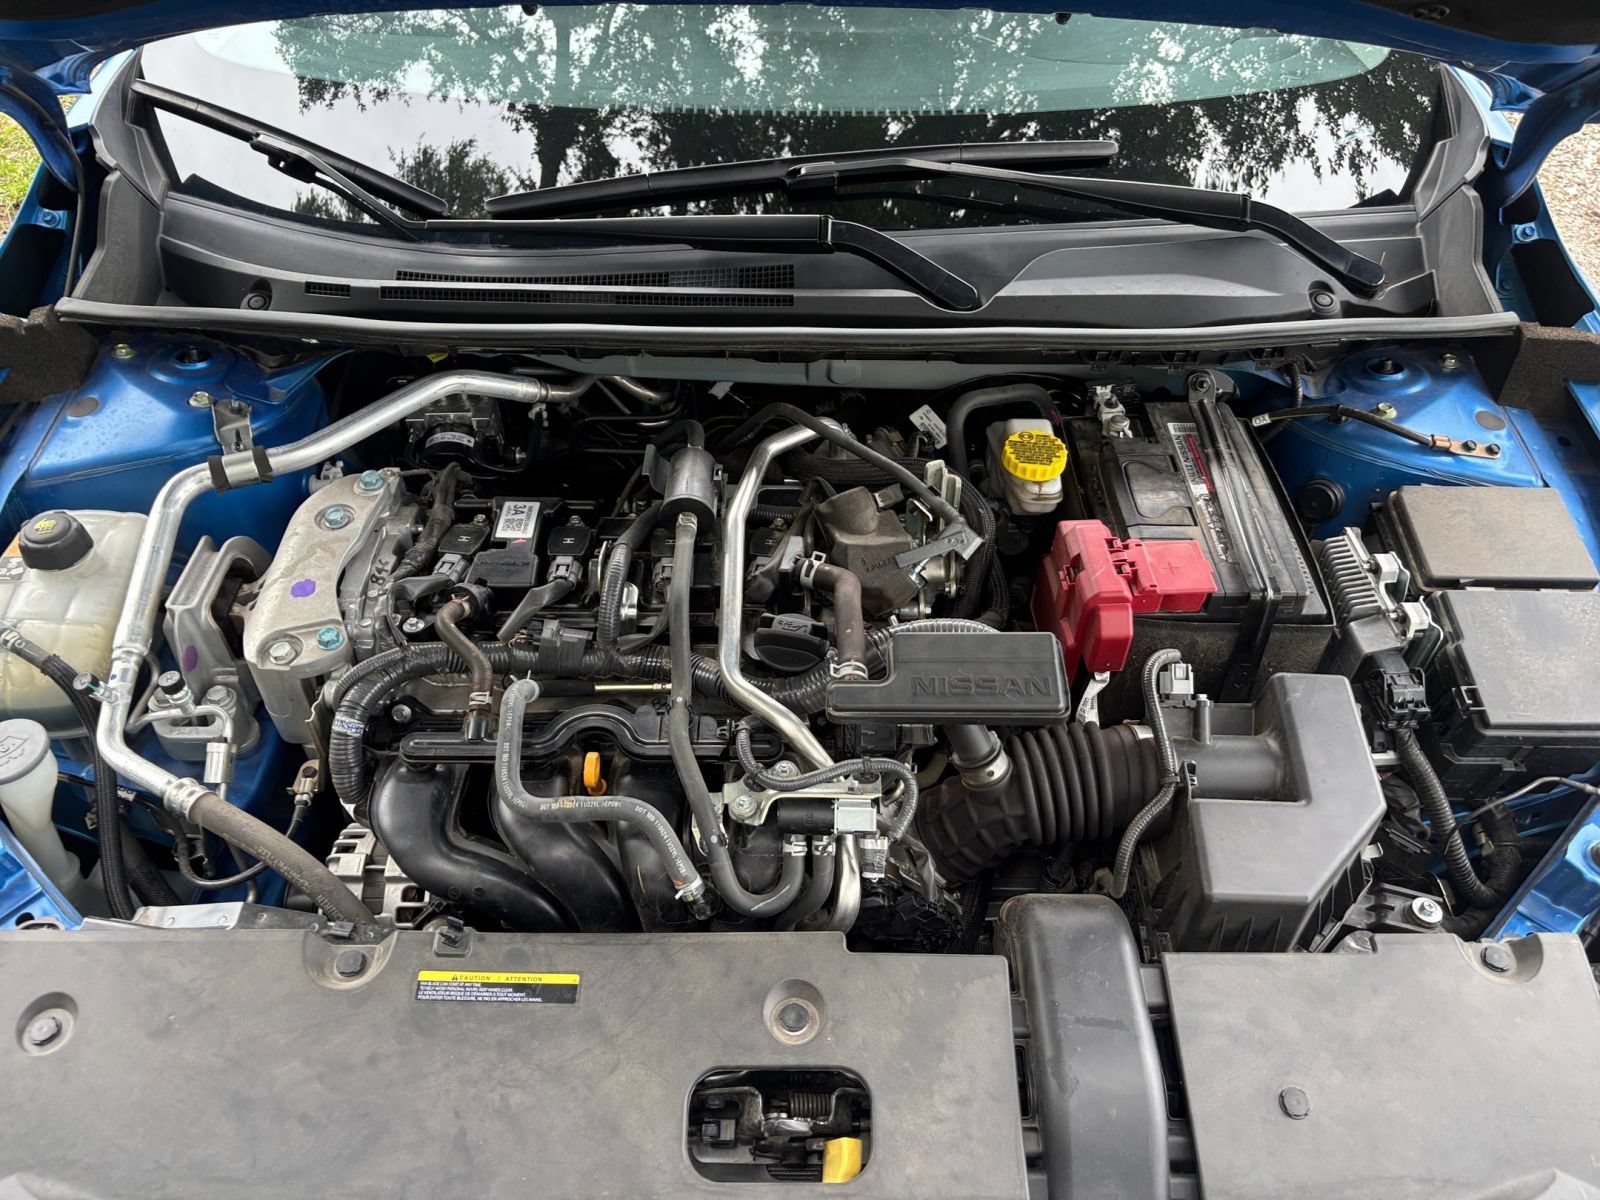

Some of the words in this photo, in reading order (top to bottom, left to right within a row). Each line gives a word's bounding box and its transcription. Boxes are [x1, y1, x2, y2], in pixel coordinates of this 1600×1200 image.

[1174, 434, 1191, 463] NISSAN
[511, 504, 527, 516] 3A
[911, 675, 1052, 696] NISSAN
[634, 804, 647, 815] DOT
